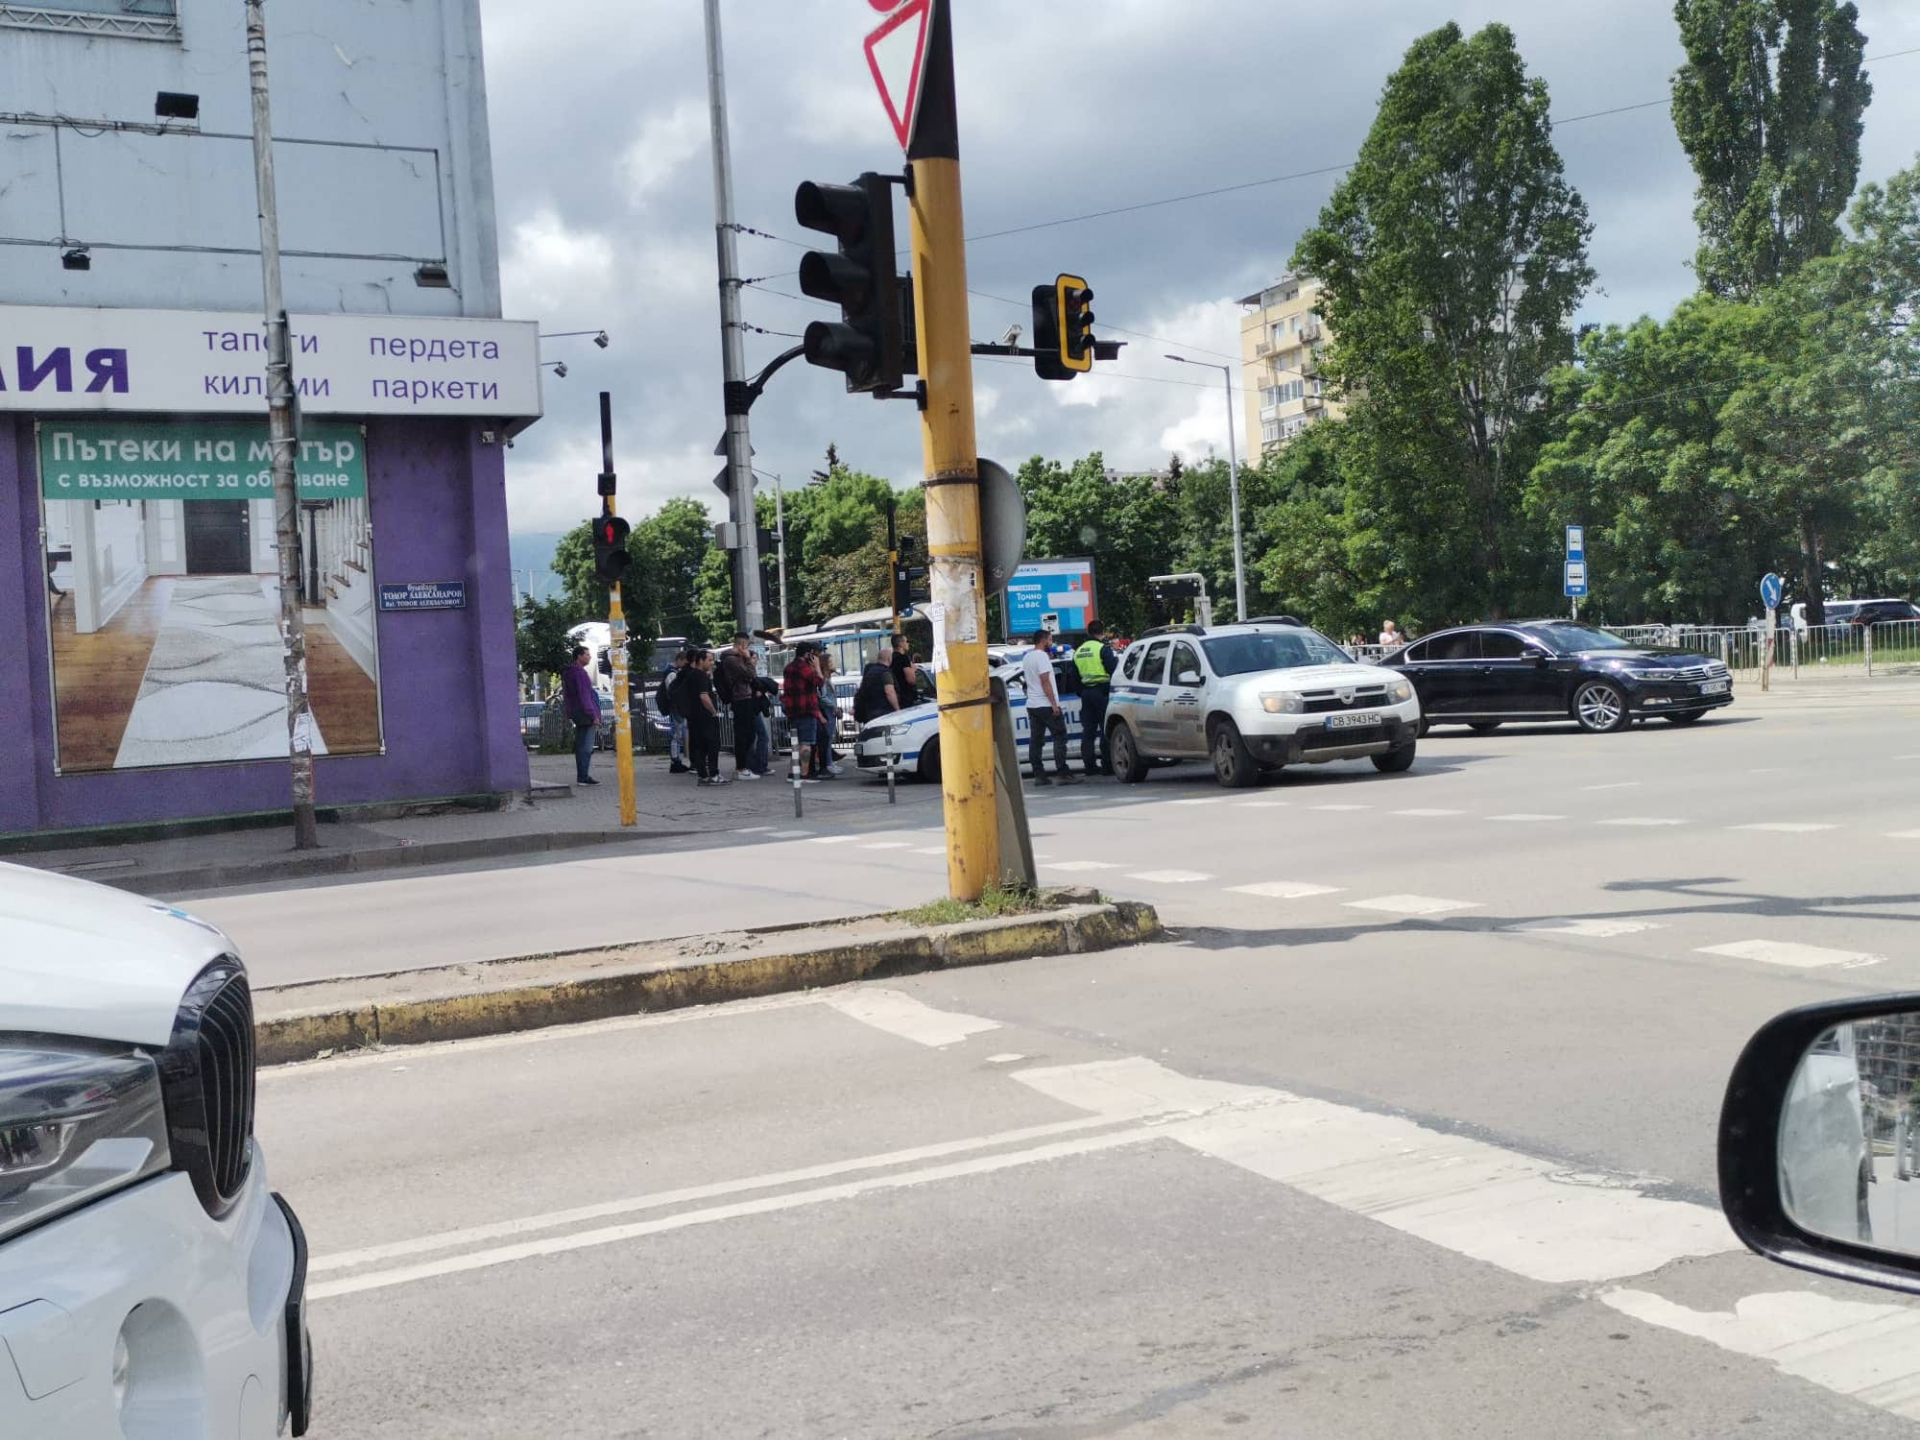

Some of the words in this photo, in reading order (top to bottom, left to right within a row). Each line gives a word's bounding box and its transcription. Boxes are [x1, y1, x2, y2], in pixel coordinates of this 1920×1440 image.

[203, 331, 318, 353] тапи
[370, 337, 499, 362] пердета
[204, 375, 329, 396] килми
[372, 379, 498, 404] паркети
[53, 432, 182, 461] Пътеки
[194, 440, 236, 461] на
[248, 441, 355, 468] мтър
[78, 474, 209, 488] възможност
[216, 473, 238, 487] за
[245, 470, 349, 487] обване
